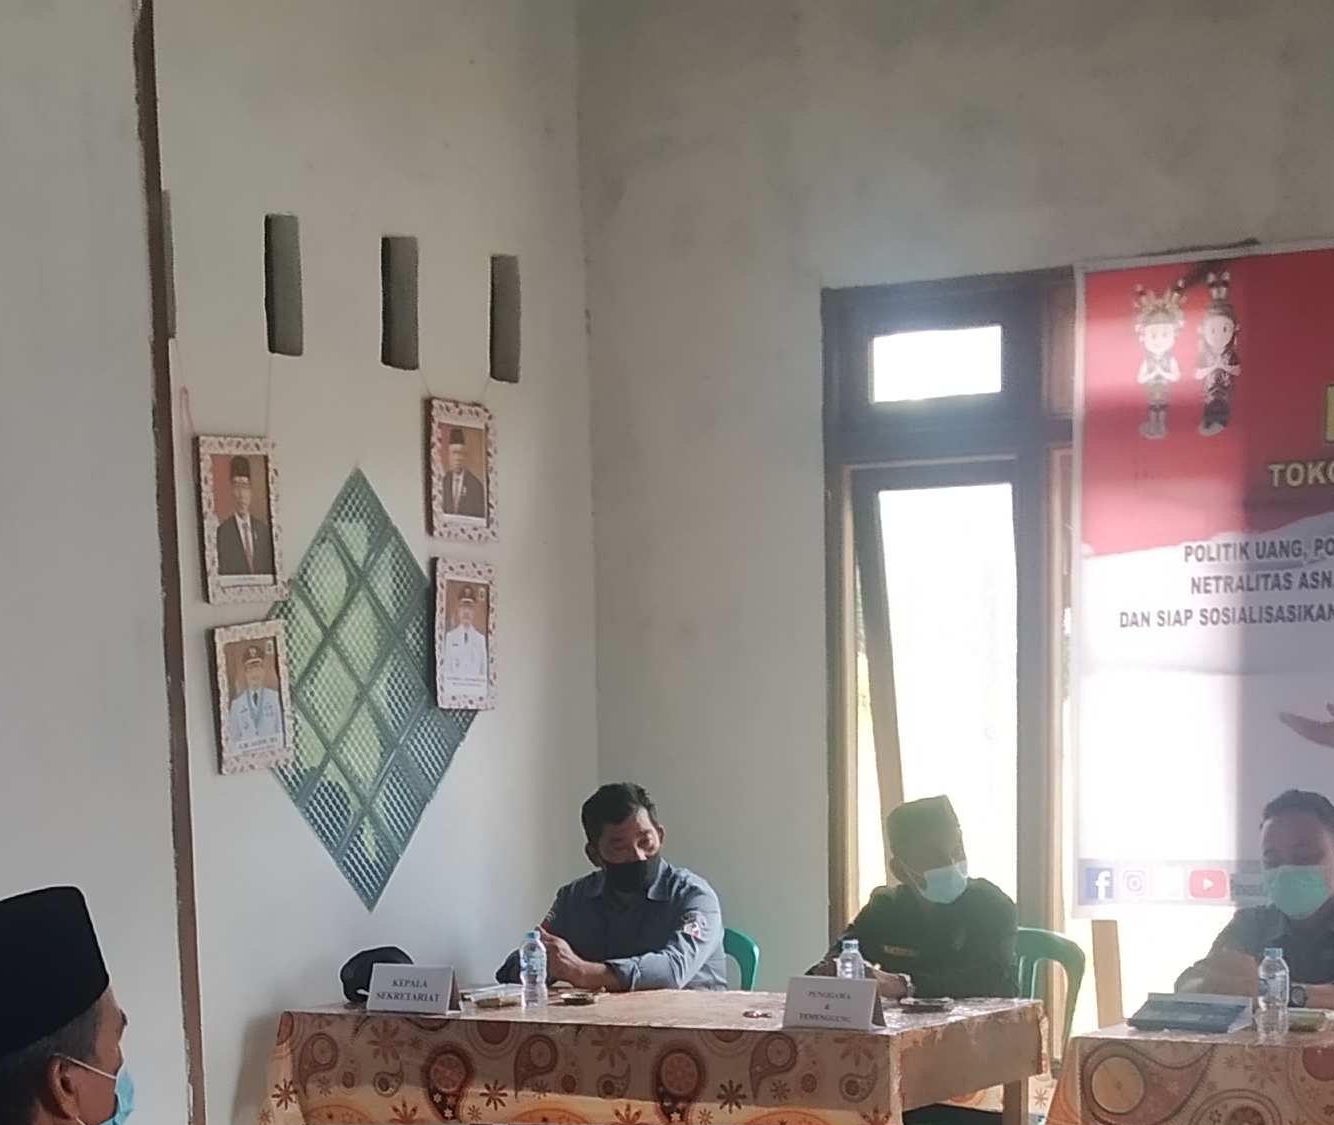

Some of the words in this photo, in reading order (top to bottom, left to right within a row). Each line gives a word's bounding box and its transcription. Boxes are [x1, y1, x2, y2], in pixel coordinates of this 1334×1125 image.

[1183, 541, 1250, 563] POLITIK
[1255, 538, 1307, 560] UANG,
[1191, 572, 1293, 595] NETRALITAS
[1119, 611, 1151, 629] DAN
[1156, 609, 1193, 627] SIAP
[392, 979, 428, 988] KEPALA
[376, 992, 441, 1002] SEKRETARIAT
